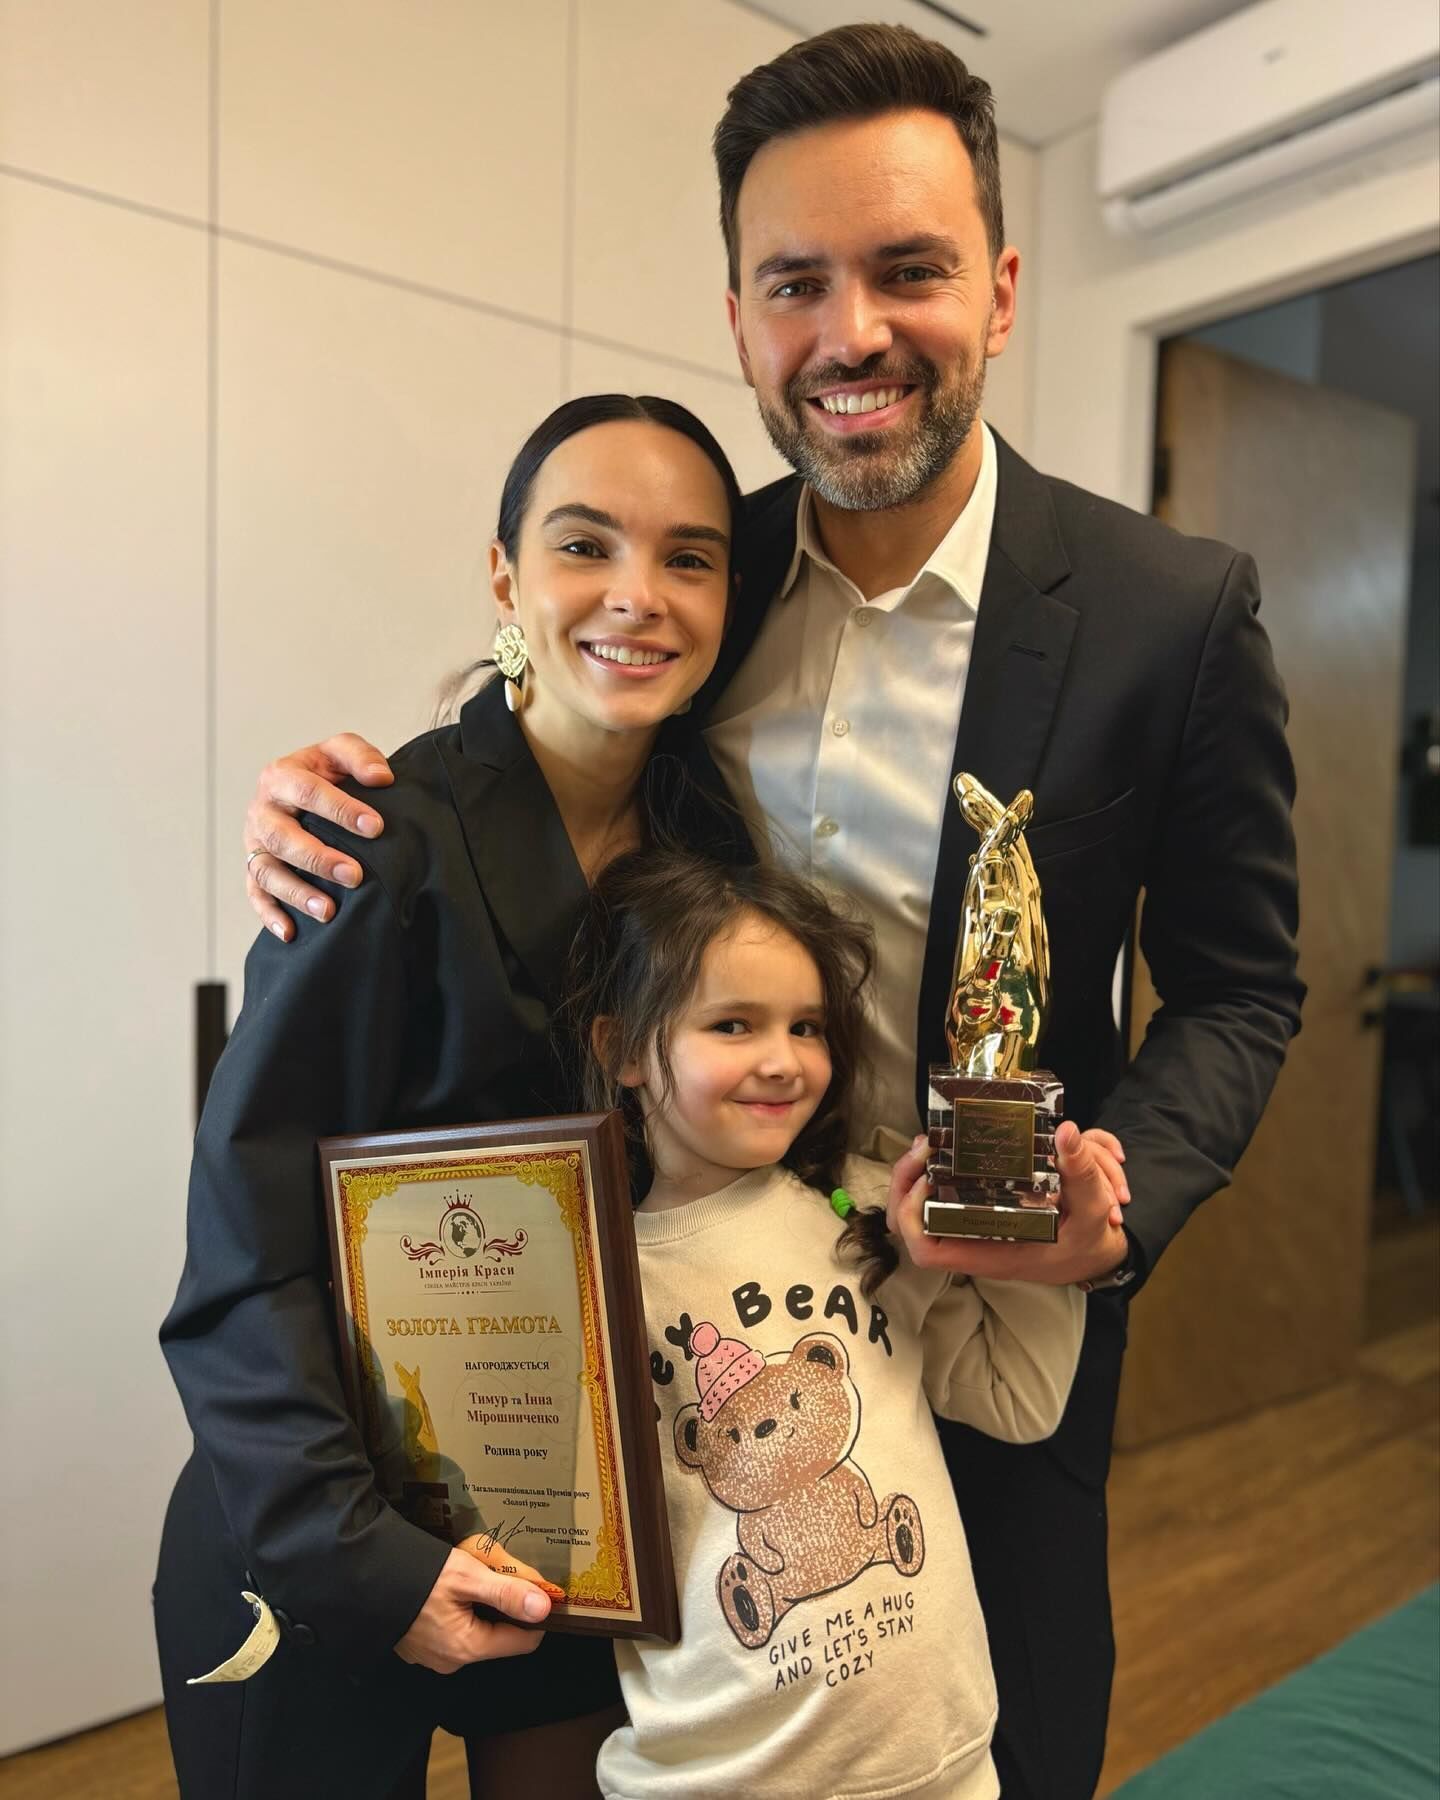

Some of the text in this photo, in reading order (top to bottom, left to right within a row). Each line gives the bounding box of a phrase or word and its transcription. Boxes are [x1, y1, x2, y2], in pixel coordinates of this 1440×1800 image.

[419, 1264, 515, 1280] Імперія Краси
[386, 1315, 563, 1337] ЗОЛОТА ГРАМОТА
[465, 1361, 550, 1372] НАГОРОДЖУЄТЬСЯ
[468, 1391, 553, 1408] Тимур та Інна
[467, 1409, 560, 1426] Мірошниченко
[484, 1444, 548, 1460] Родина року
[546, 1487, 572, 1498] Премія
[573, 1490, 591, 1500] року
[557, 1527, 567, 1535] ГО
[568, 1527, 590, 1536] СМКУ
[501, 1565, 517, 1574] 2023
[769, 1592, 914, 1665] GIVE ME A HUG
[775, 1614, 914, 1691] AND LET'S STAY
[825, 1650, 874, 1688] COZY
